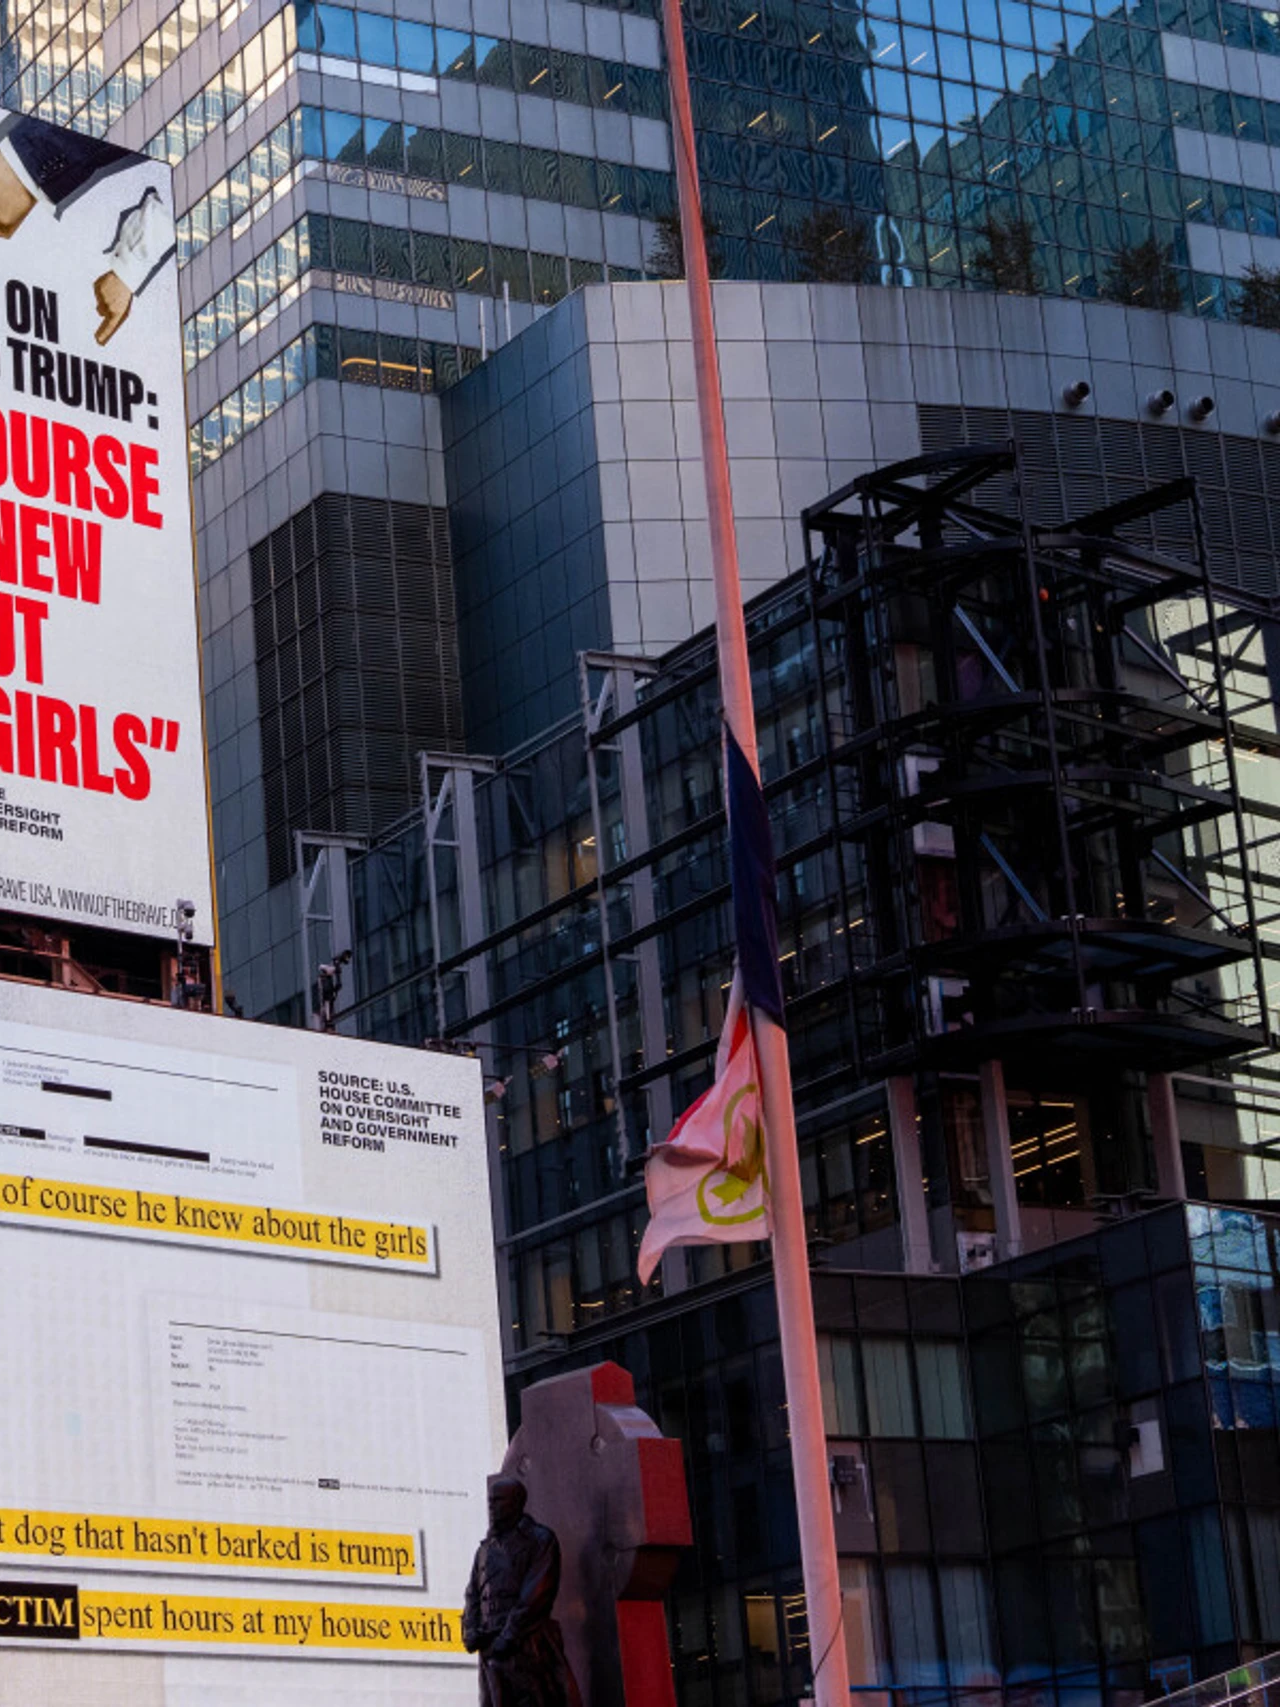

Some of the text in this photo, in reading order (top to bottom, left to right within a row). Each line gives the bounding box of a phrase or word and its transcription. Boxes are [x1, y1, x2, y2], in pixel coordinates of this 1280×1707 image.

[5, 278, 59, 344] ON
[6, 336, 159, 430] TRUMP:
[29, 883, 56, 908] USA.
[318, 1070, 415, 1097] SOURCE: U.S.
[319, 1086, 462, 1119] HOUSE COMMITTEE
[320, 1101, 430, 1129] ON OVERSIGHT
[320, 1116, 459, 1148] AND GOVERNMENT
[322, 1132, 386, 1153] REFORM
[2, 1176, 428, 1260] of course he knew about the girls
[14, 1514, 67, 1556] dog
[74, 1518, 126, 1553] that
[133, 1522, 209, 1558] hasn't
[218, 1526, 301, 1564] barked
[309, 1532, 330, 1565] is
[338, 1539, 417, 1577] trump.
[83, 1602, 154, 1638] spent
[162, 1600, 235, 1635] hours
[242, 1608, 265, 1637] at
[272, 1613, 314, 1645] my
[321, 1608, 392, 1642] house
[399, 1613, 453, 1643] with
